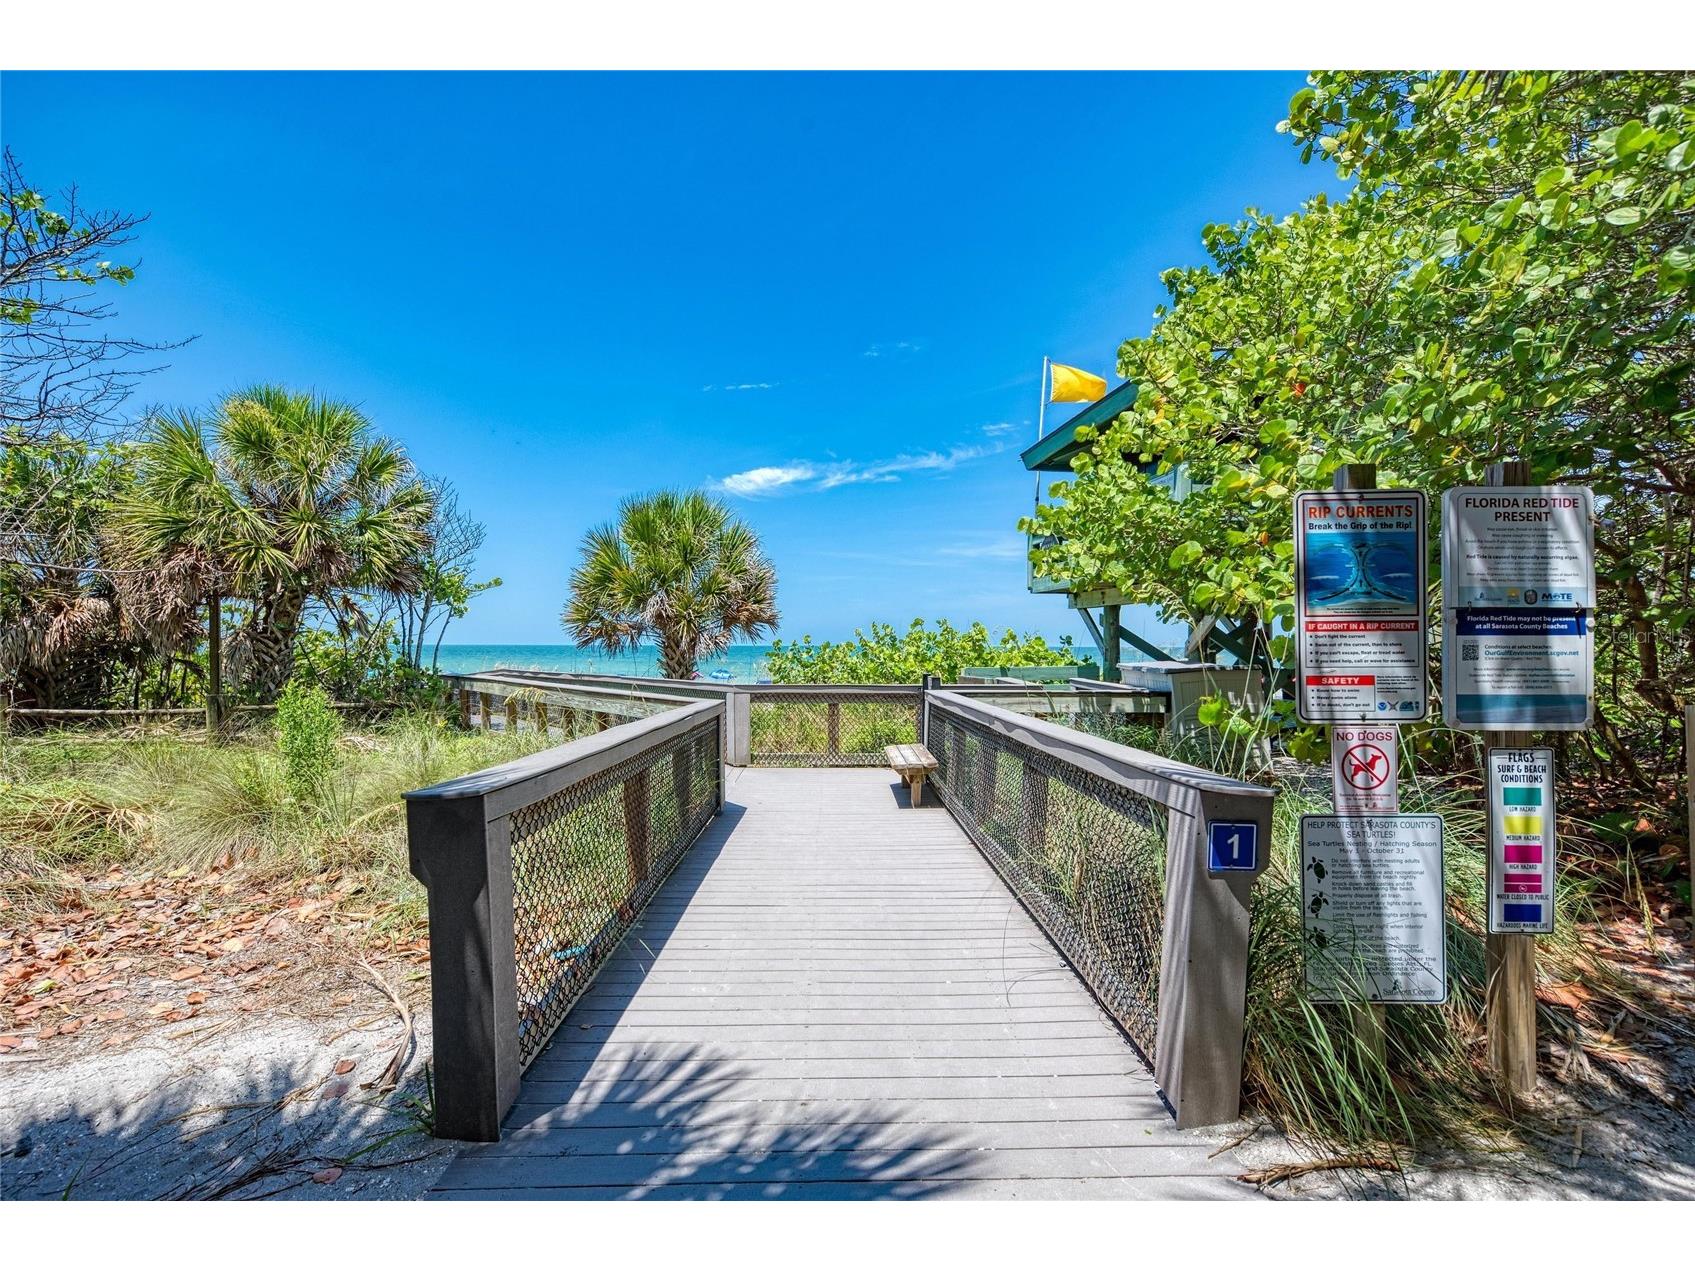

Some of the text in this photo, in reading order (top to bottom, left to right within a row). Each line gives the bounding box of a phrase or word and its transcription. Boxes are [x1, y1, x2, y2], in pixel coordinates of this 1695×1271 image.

[1465, 498, 1579, 508] FLORIDA RED TIDE
[1308, 506, 1413, 518] RIP CURRENTS
[1495, 512, 1550, 522] PRESENT
[1308, 522, 1332, 530] Break
[1335, 522, 1348, 530] the
[1350, 522, 1367, 531] Grip
[1396, 522, 1412, 530] Rip!
[1322, 677, 1360, 685] SAFETY
[1336, 732, 1393, 741] NO DOGS
[1508, 753, 1535, 762] FLAGS
[1498, 765, 1547, 773] SURF & BEACH
[1501, 775, 1543, 783] CONDITIONS
[1308, 821, 1436, 829] HELP PROTECT SARASOTA COUNTY'S
[1227, 834, 1239, 859] 1
